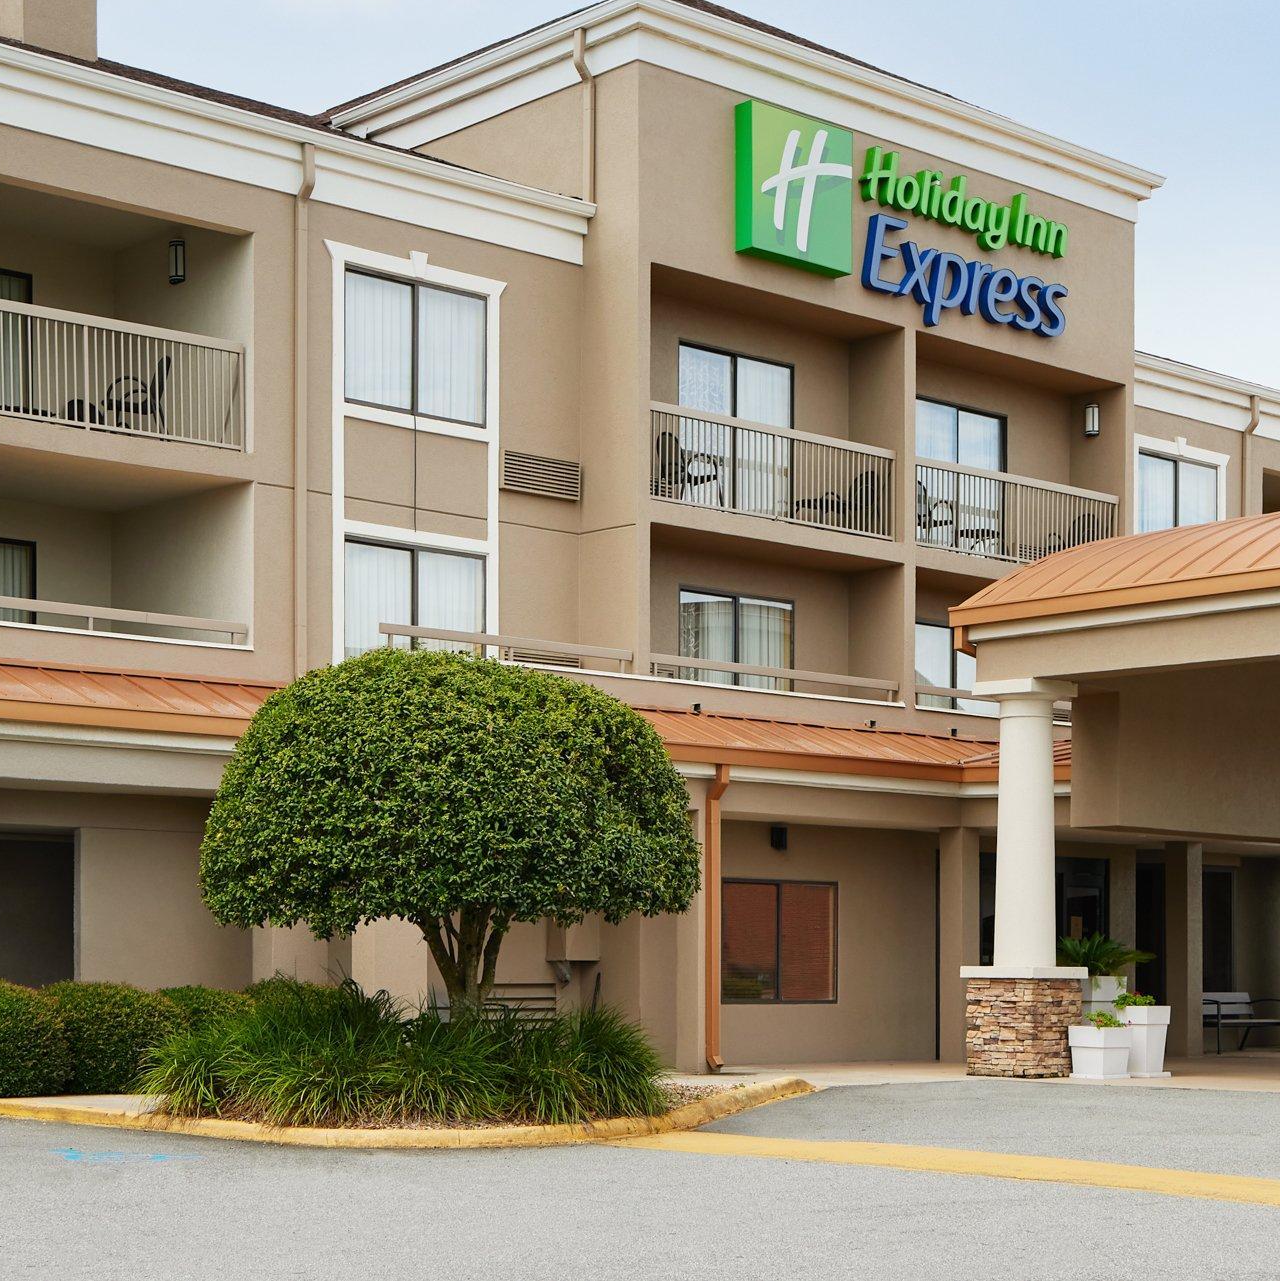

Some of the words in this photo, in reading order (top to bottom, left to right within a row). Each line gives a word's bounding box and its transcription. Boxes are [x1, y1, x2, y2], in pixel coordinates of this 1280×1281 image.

[858, 146, 1010, 251] Holiday
[1008, 193, 1069, 259] Inn
[861, 213, 1069, 337] Express
